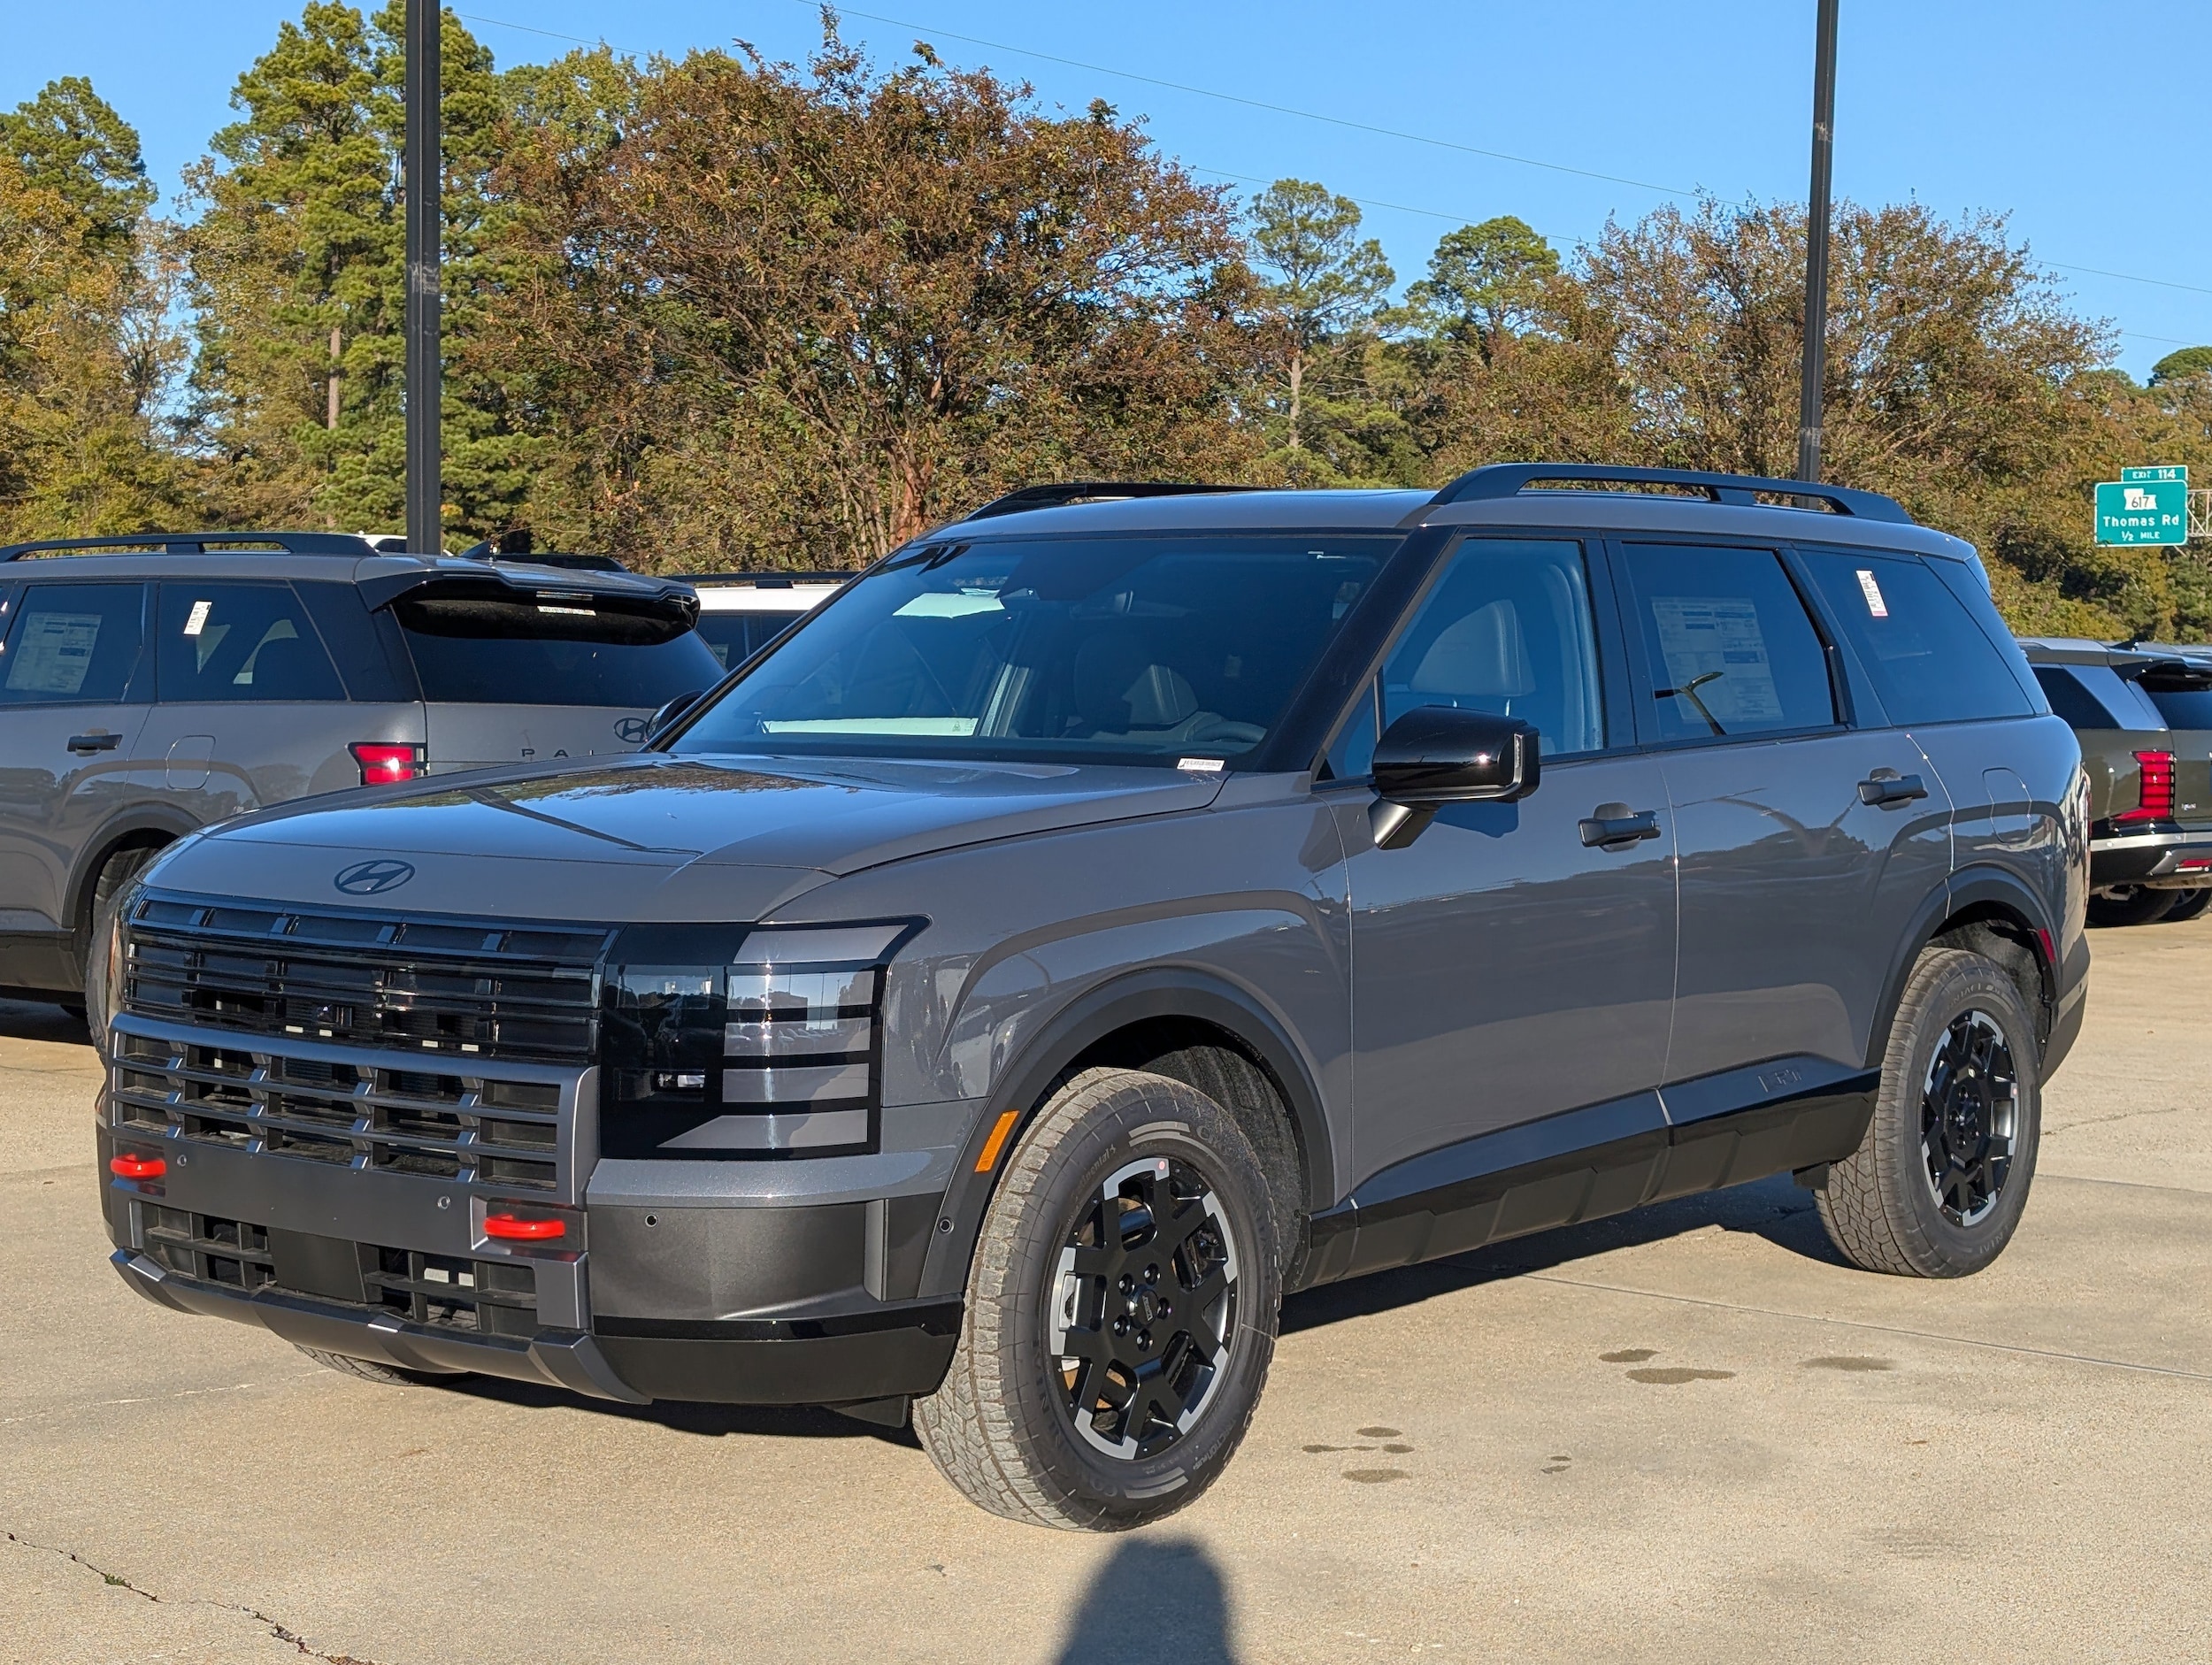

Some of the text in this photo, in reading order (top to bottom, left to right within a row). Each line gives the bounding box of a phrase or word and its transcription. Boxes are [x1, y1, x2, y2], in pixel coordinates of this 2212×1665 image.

[2158, 469, 2176, 479] 114
[2131, 496, 2149, 508] 617
[2103, 514, 2179, 527] Thomas Rd
